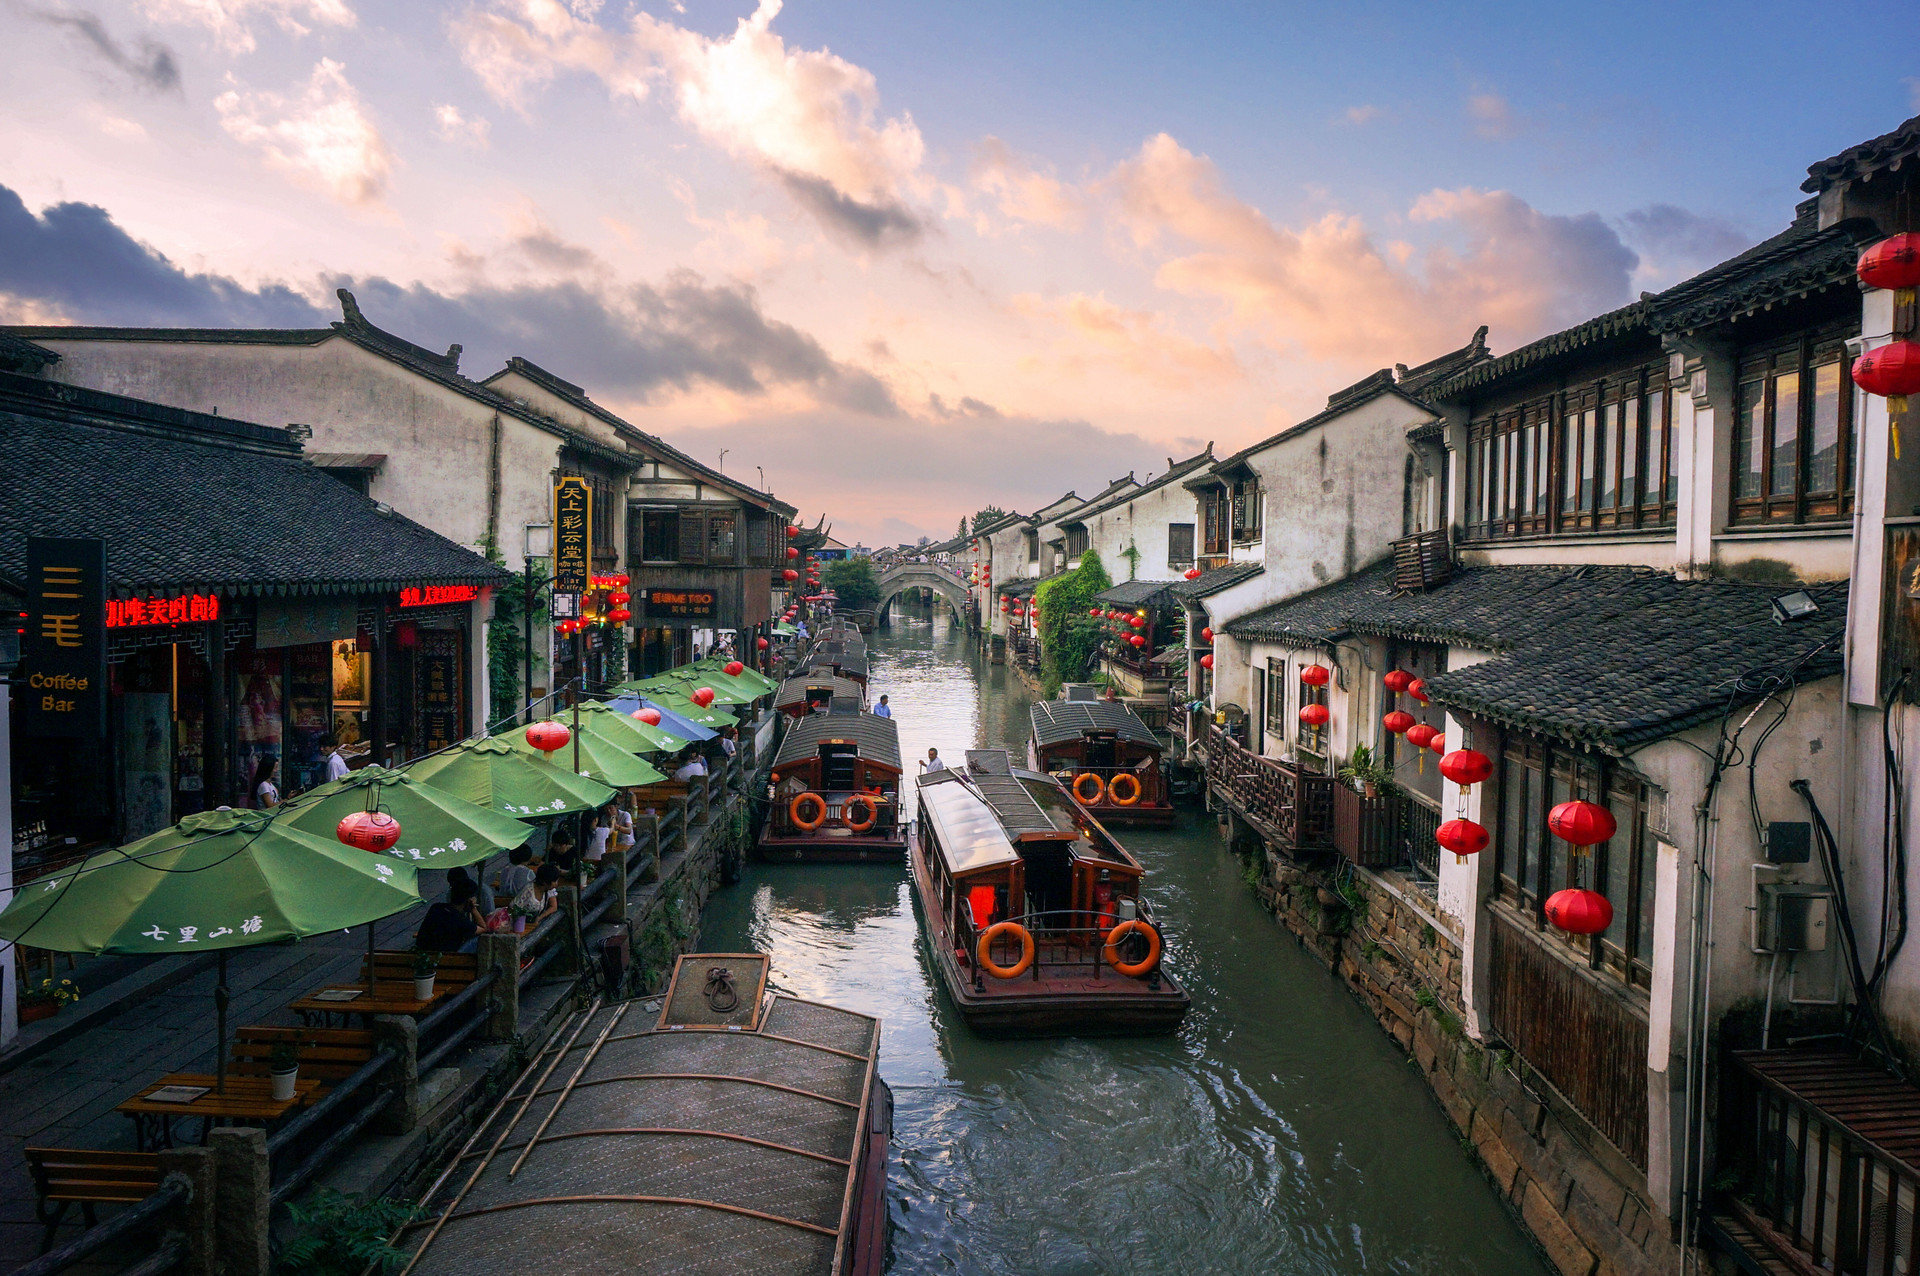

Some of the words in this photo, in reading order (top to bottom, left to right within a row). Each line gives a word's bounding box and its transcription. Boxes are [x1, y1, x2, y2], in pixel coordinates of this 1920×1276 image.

[561, 487, 583, 559] 天上彩云堂
[558, 560, 585, 568] 咖啡
[42, 567, 84, 647] 三毛
[29, 671, 89, 691] Coffee
[42, 694, 76, 713] Bar
[389, 837, 468, 861] 七里山塘
[140, 914, 264, 944] 七里山塘
